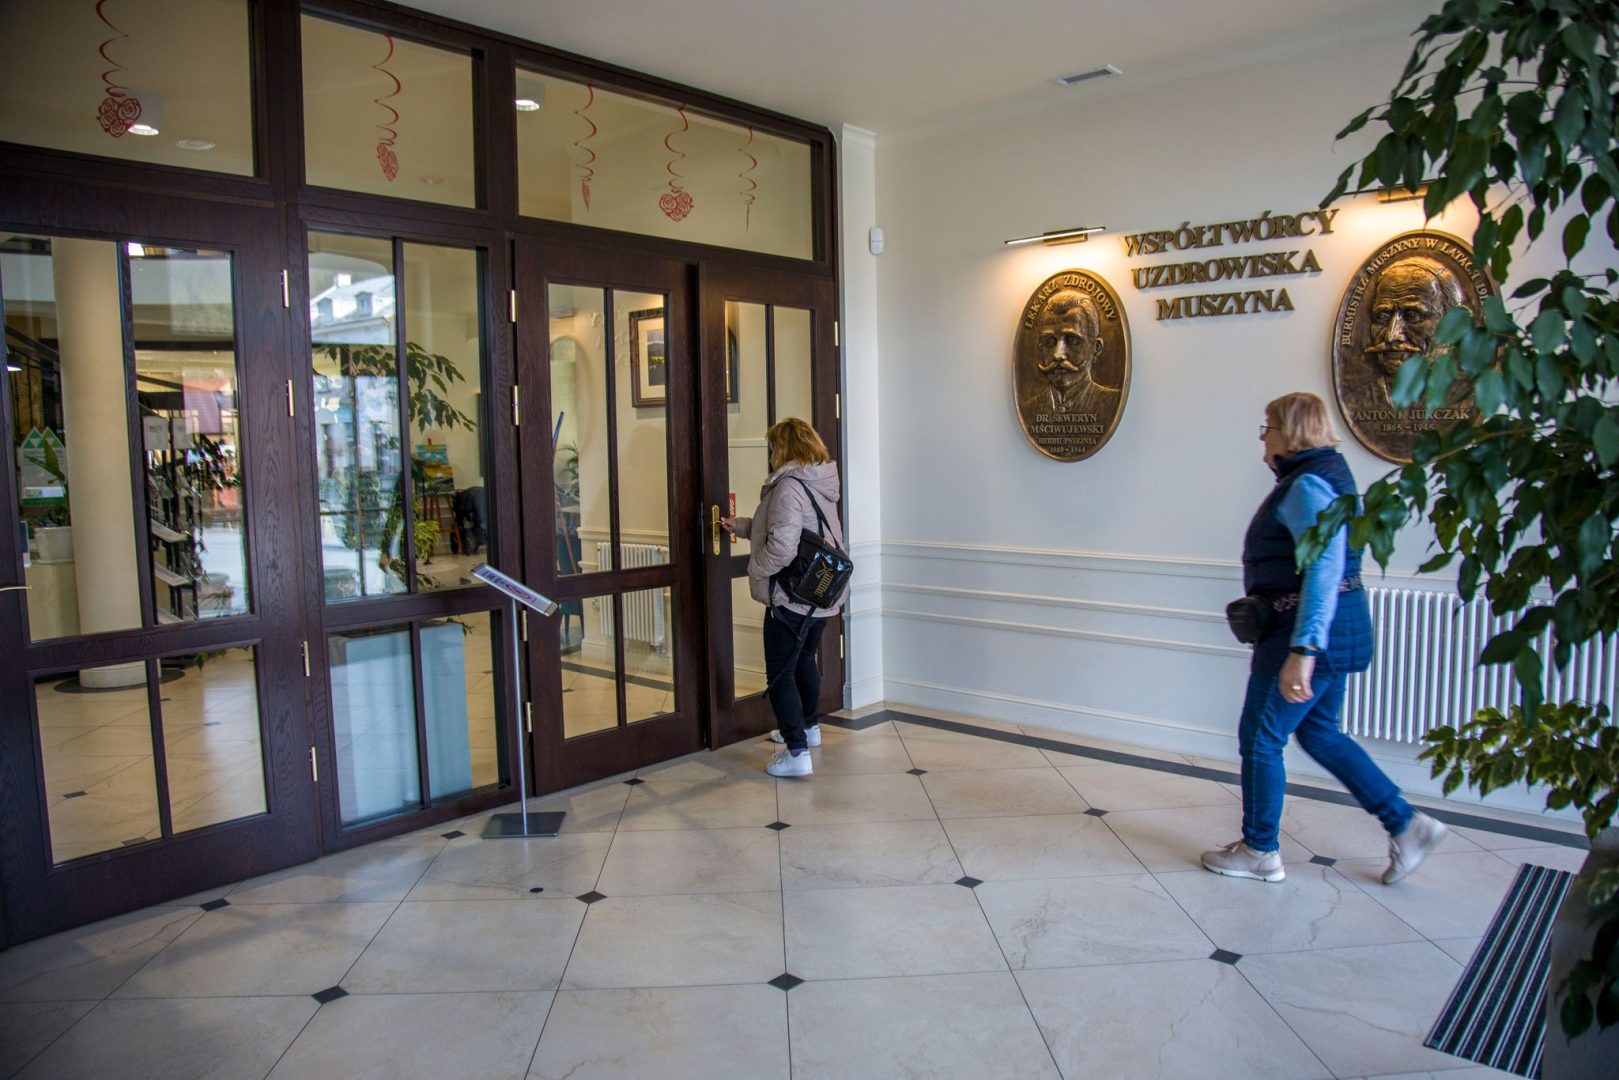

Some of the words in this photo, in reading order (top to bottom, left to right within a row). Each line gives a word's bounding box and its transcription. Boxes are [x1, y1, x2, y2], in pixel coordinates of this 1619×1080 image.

[1119, 209, 1339, 257] WSPÓŁTWÓRCY
[1131, 249, 1323, 289] UZDROWISKA
[1024, 280, 1058, 329] LEKARZ
[1063, 274, 1116, 322] ZDROJOWY
[1155, 288, 1295, 321] MUSZYNA
[1342, 277, 1369, 345] BURMISTRZ
[1368, 238, 1420, 275] MUSZYNY
[1425, 237, 1439, 249] W
[1031, 423, 1104, 434] MŚCIWUJEWSKI
[1036, 413, 1049, 423] DR
[1053, 413, 1097, 423] SEWERYN
[1354, 410, 1402, 420] ANTONI
[1039, 437, 1062, 445] HERBU
